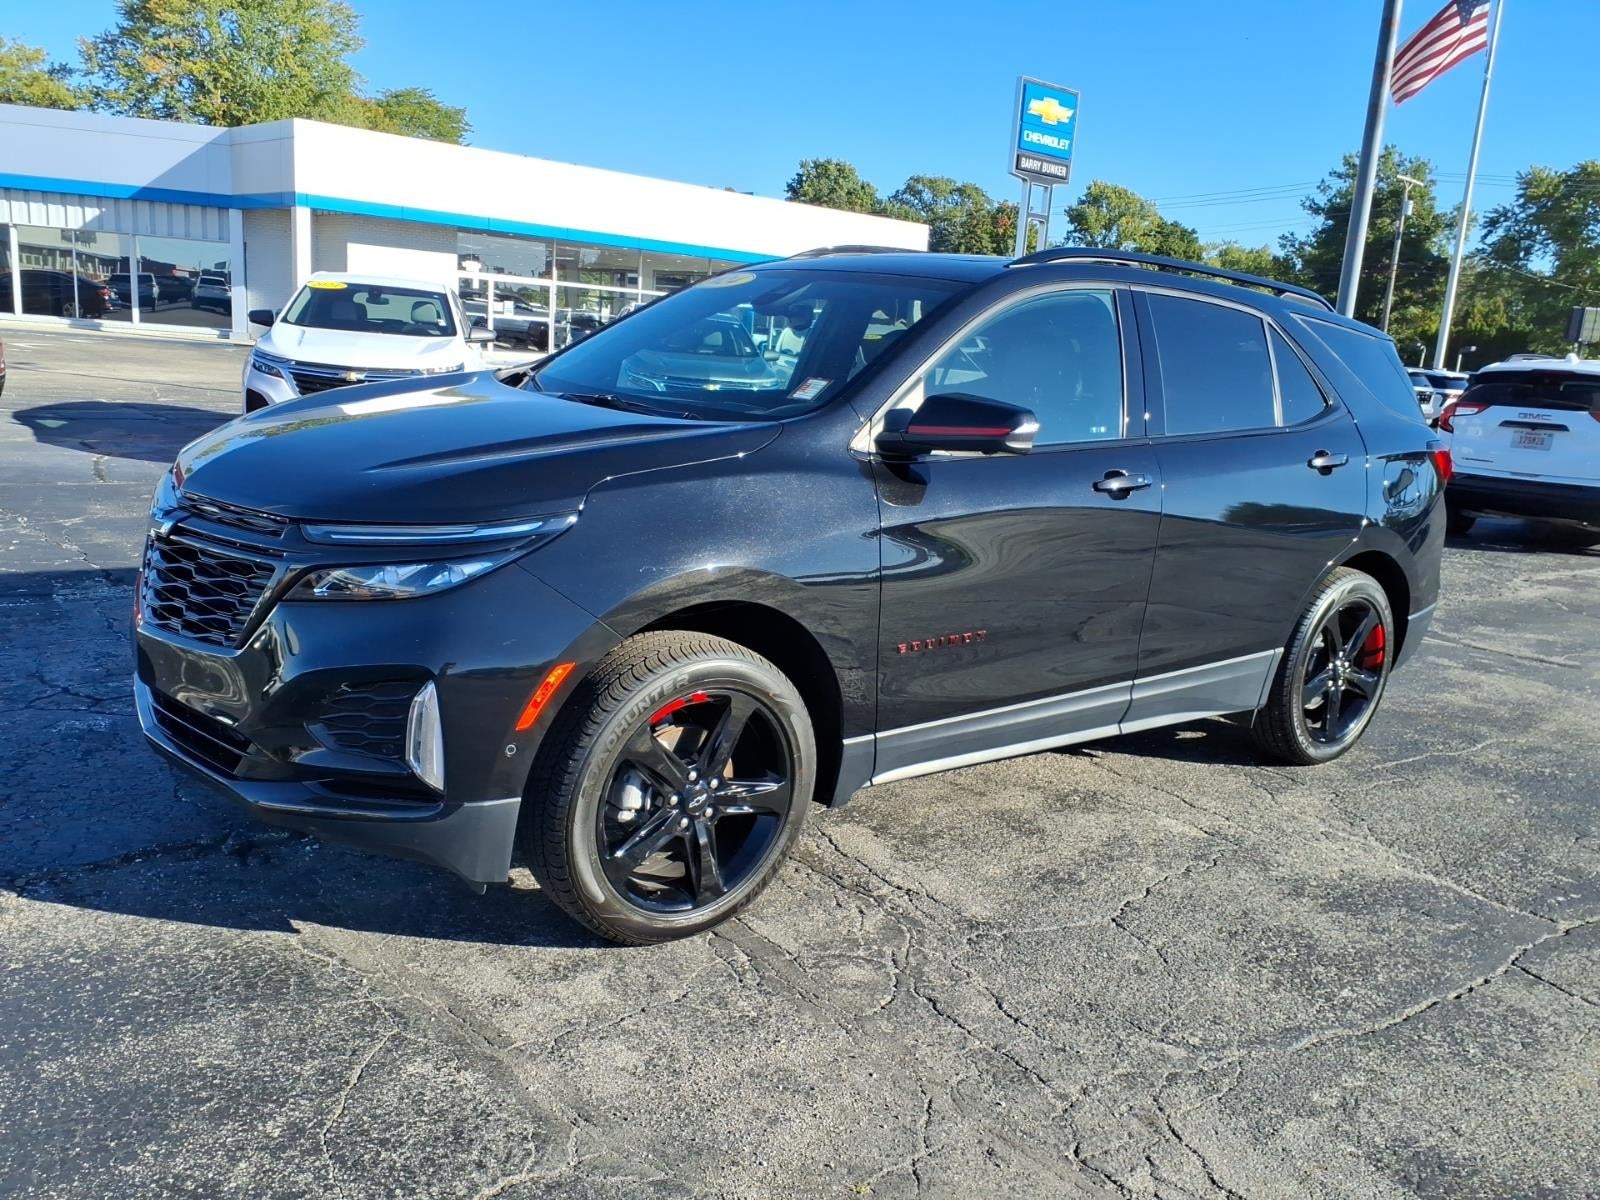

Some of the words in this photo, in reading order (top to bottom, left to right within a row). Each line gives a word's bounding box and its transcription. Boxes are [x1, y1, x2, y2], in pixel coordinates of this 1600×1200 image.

[1024, 131, 1070, 149] CHEVROLET
[1021, 158, 1041, 171] BARRY
[1043, 162, 1067, 177] BUNKER
[1518, 412, 1553, 421] GMC
